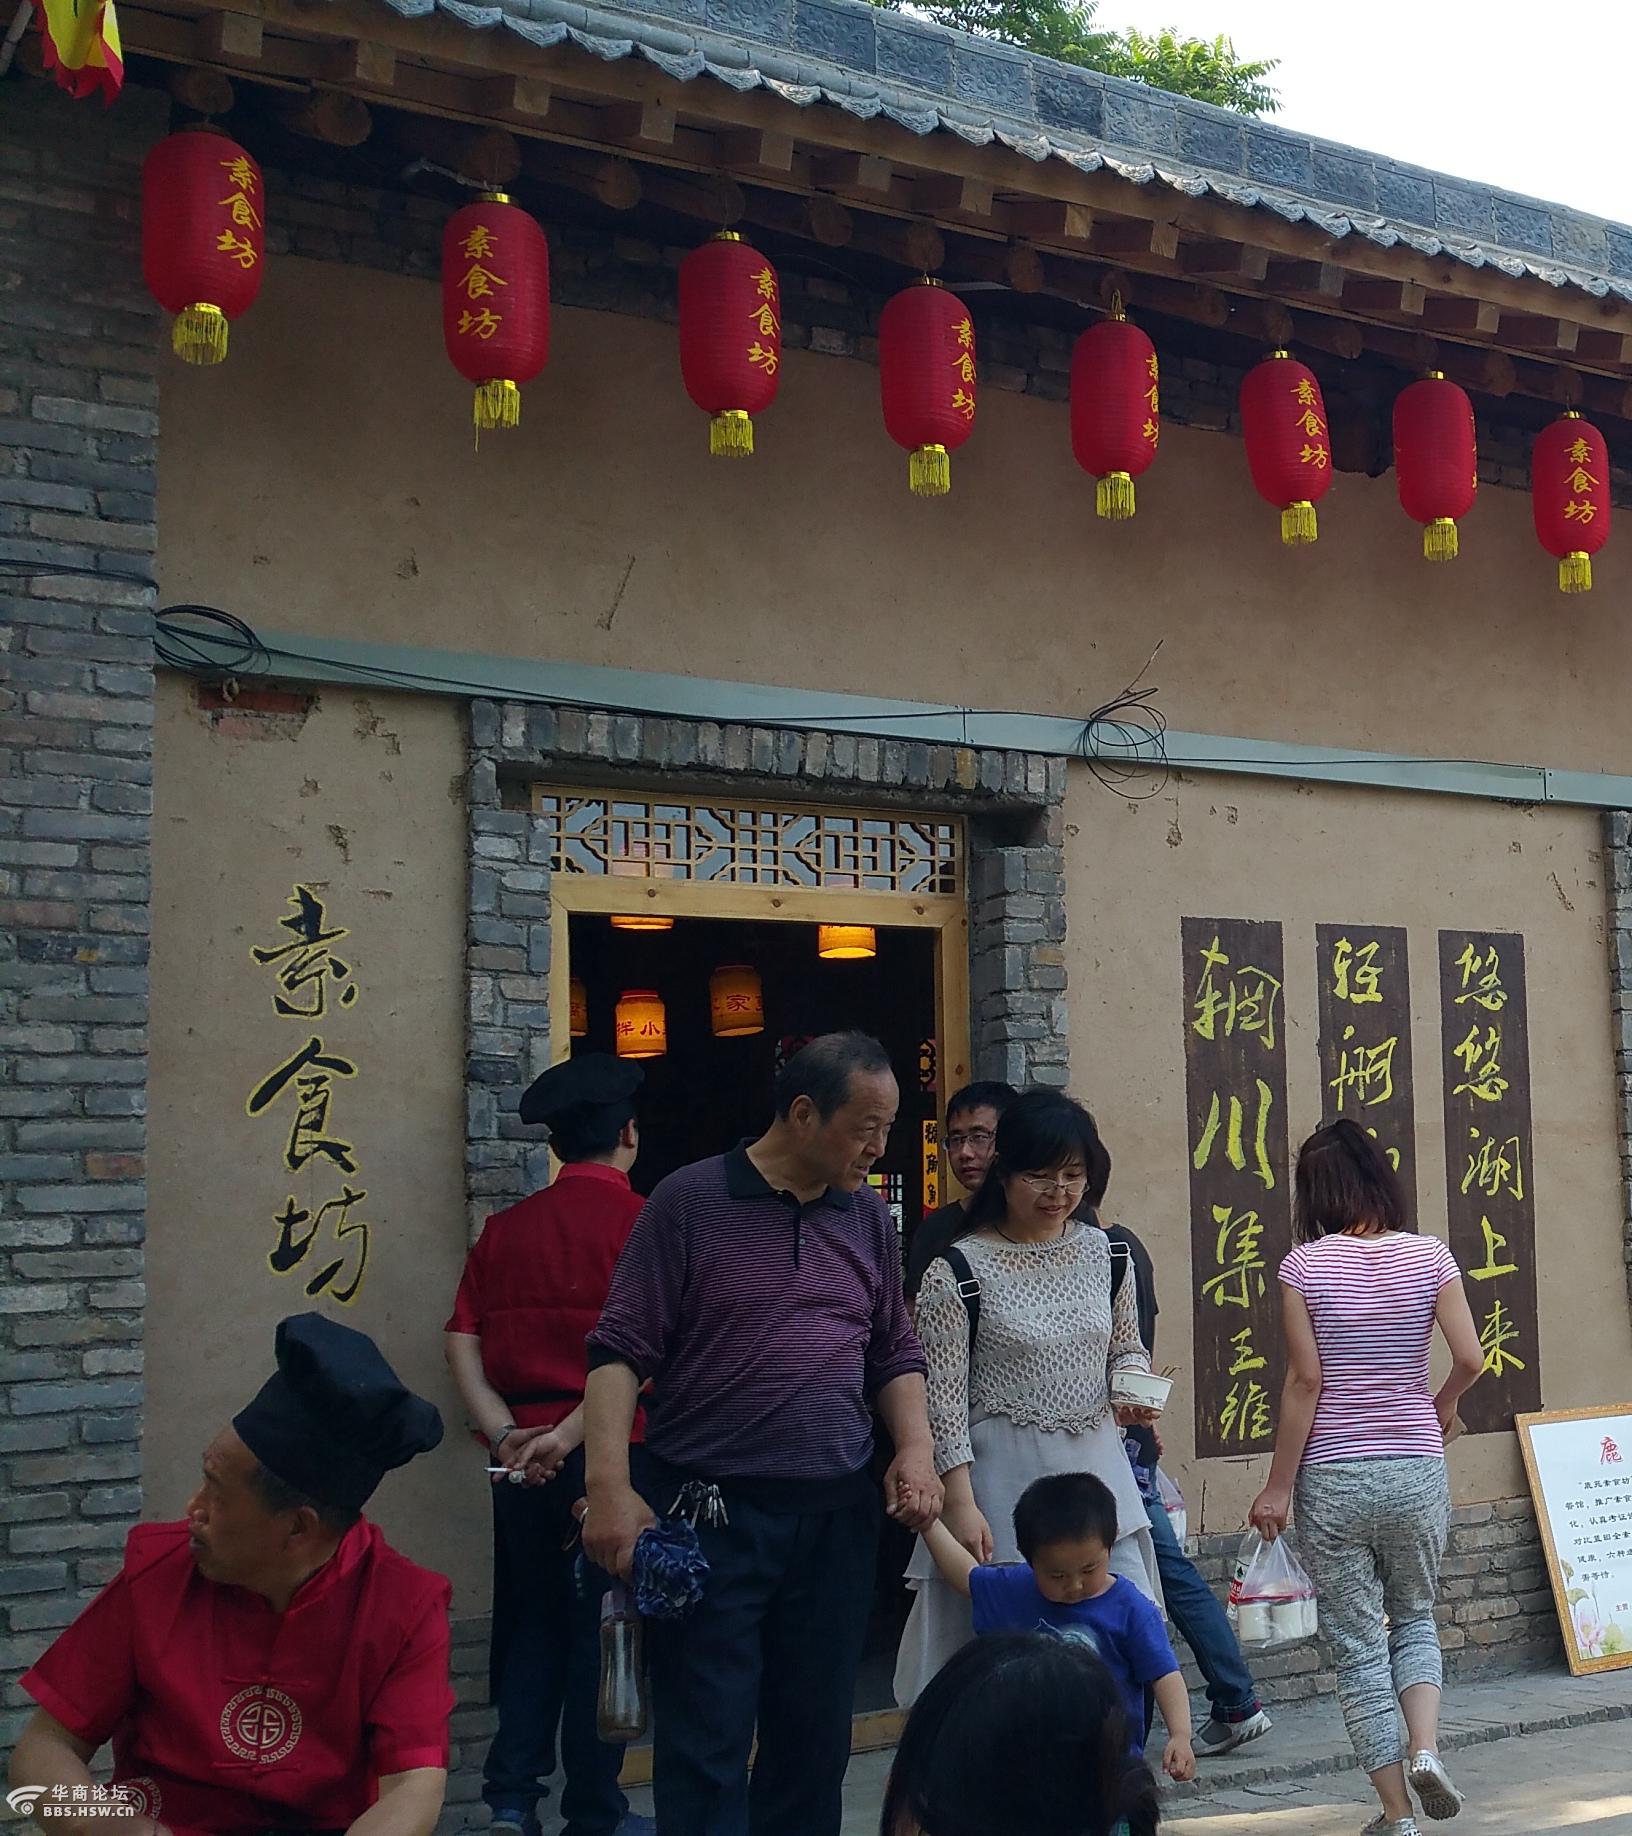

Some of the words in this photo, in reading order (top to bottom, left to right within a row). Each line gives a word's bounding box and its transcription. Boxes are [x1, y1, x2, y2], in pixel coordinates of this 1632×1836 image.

[217, 156, 260, 269] 素食坊
[459, 226, 507, 339] 素食坊
[747, 267, 781, 375] 素食坊
[951, 318, 977, 420] 素食坊
[1292, 378, 1329, 470] 素食坊
[1564, 438, 1600, 524] 素食坊
[246, 884, 372, 1305] 素食坊
